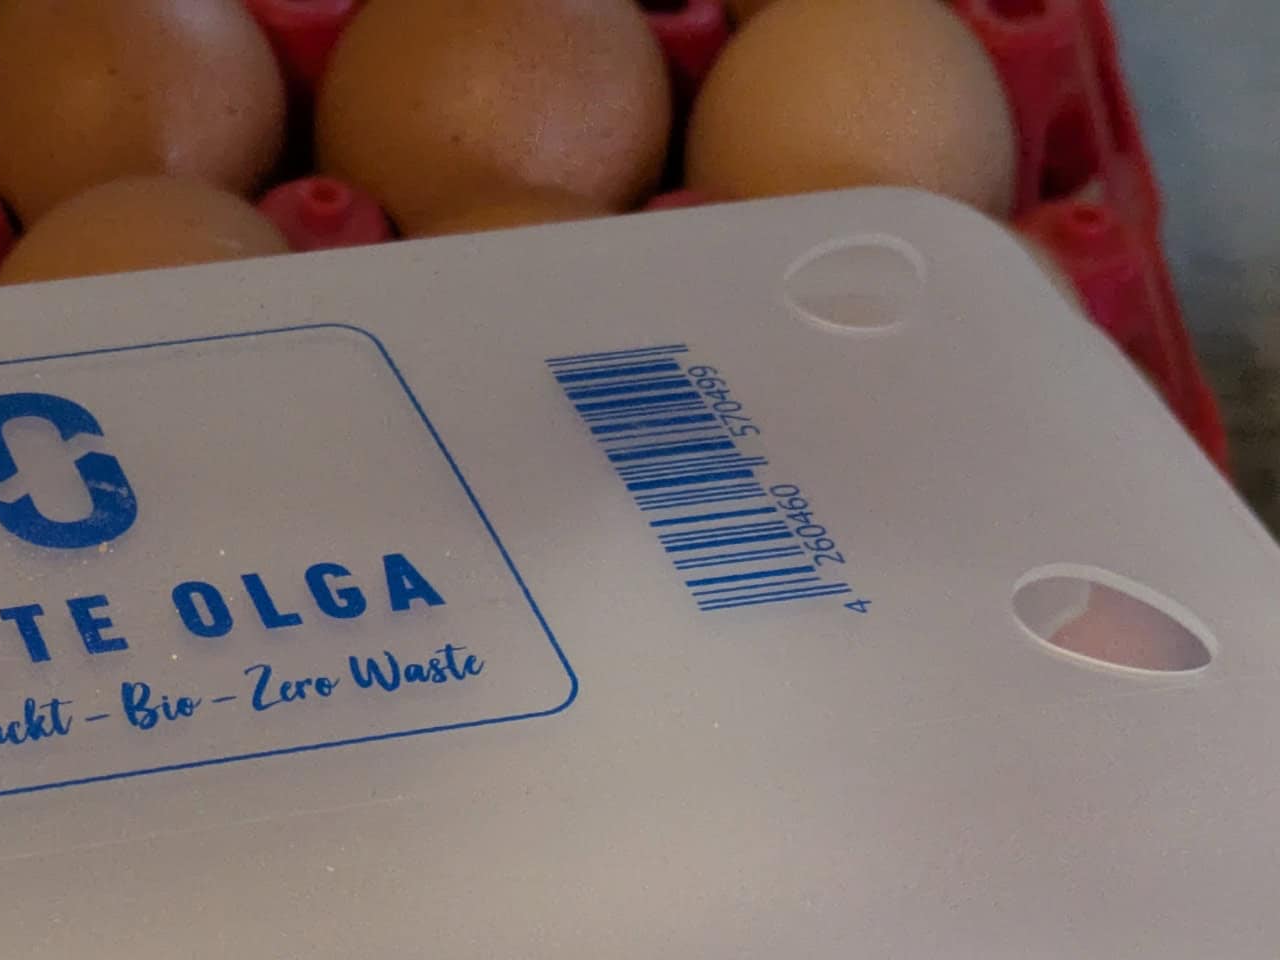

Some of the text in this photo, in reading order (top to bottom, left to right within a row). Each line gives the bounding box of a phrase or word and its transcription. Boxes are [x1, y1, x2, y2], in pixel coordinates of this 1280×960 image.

[687, 364, 872, 614] 4 260460 570499
[171, 553, 446, 638] OLGA
[121, 681, 203, 730] Bio
[243, 663, 340, 711] Zero
[348, 643, 485, 692] Waste
